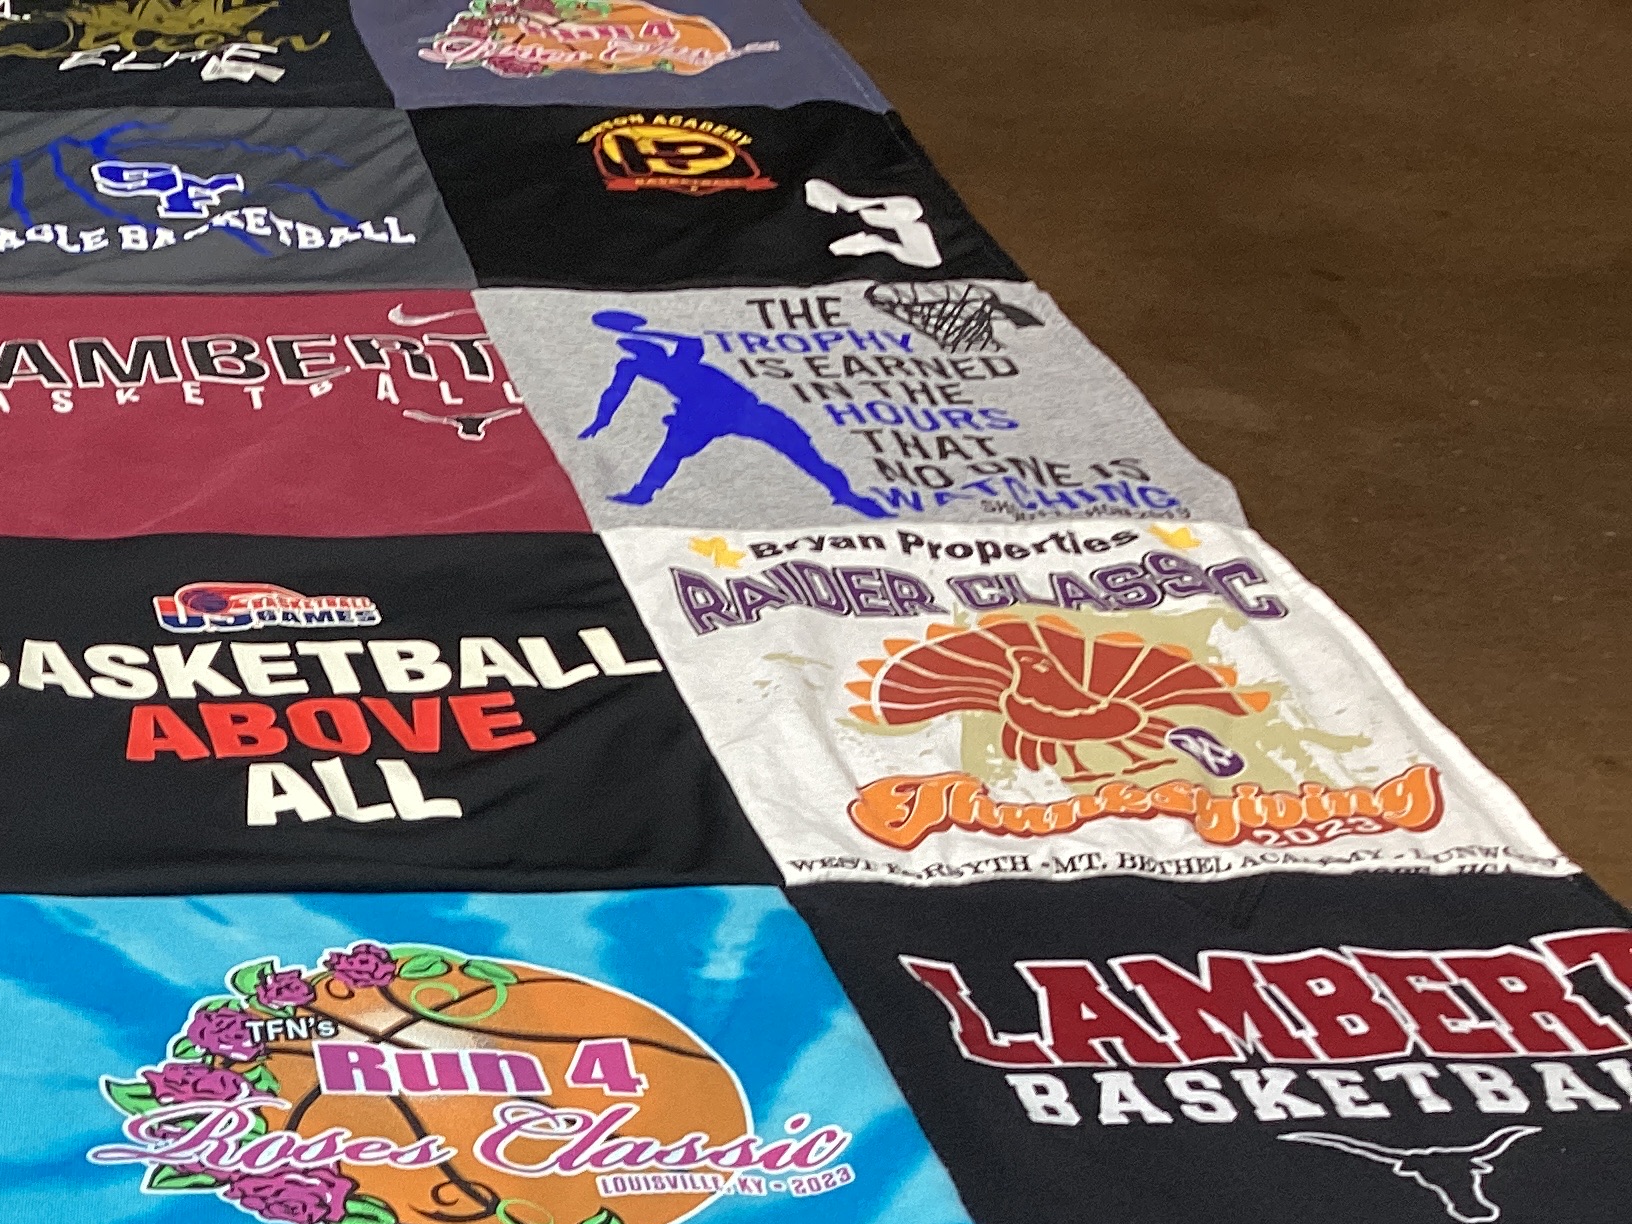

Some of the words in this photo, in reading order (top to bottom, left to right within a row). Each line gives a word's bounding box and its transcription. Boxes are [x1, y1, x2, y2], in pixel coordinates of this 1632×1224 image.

[805, 178, 943, 269] 3
[747, 296, 852, 330] THE
[702, 326, 915, 356] TROPHY
[738, 356, 794, 380] IS
[807, 355, 1021, 381] EARNED
[791, 381, 849, 403] IN
[853, 379, 974, 407] THE
[825, 402, 1020, 432] HOURS
[849, 428, 1002, 462] THAT
[872, 457, 955, 490] NO
[966, 455, 1084, 488] ONE
[1089, 457, 1152, 482] IS
[868, 475, 1181, 513] WATCHING
[749, 531, 885, 561] Bryan
[897, 526, 1141, 565] Properties
[669, 560, 947, 638] RAIDER
[946, 550, 1289, 619] CLASSC
[125, 691, 537, 762] ABOVE
[247, 756, 463, 827] ALL
[846, 764, 1444, 850] Thanksgiving
[1253, 816, 1384, 848] 2023
[1053, 851, 1108, 874] MT.
[1115, 851, 1233, 875] BETHEL
[243, 1012, 340, 1046] TFN's
[312, 1041, 552, 1099] Run
[565, 1037, 649, 1100] 4
[86, 1090, 460, 1173] Roses
[471, 1101, 855, 1178] Classic
[738, 1176, 766, 1194] KY
[791, 1166, 854, 1196] 2023
